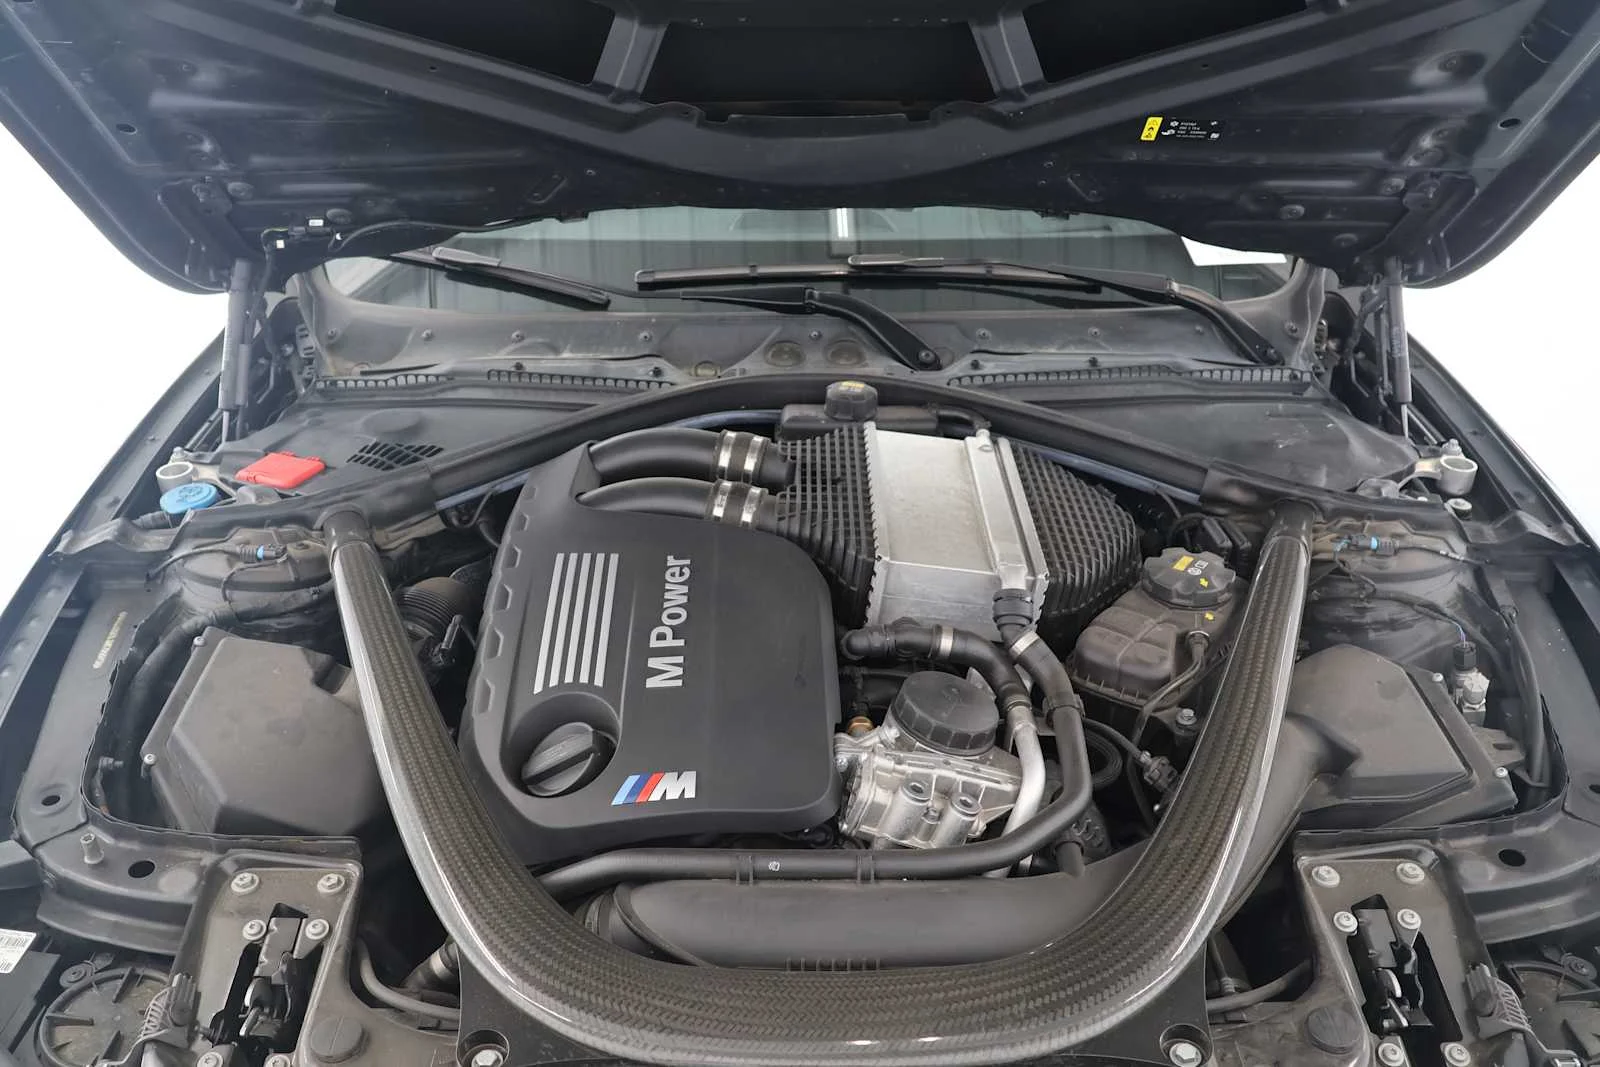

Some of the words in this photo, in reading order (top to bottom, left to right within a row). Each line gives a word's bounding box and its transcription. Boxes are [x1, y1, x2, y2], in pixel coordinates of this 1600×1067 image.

[649, 555, 691, 648] Power
[646, 655, 684, 689] M
[647, 770, 697, 802] M
